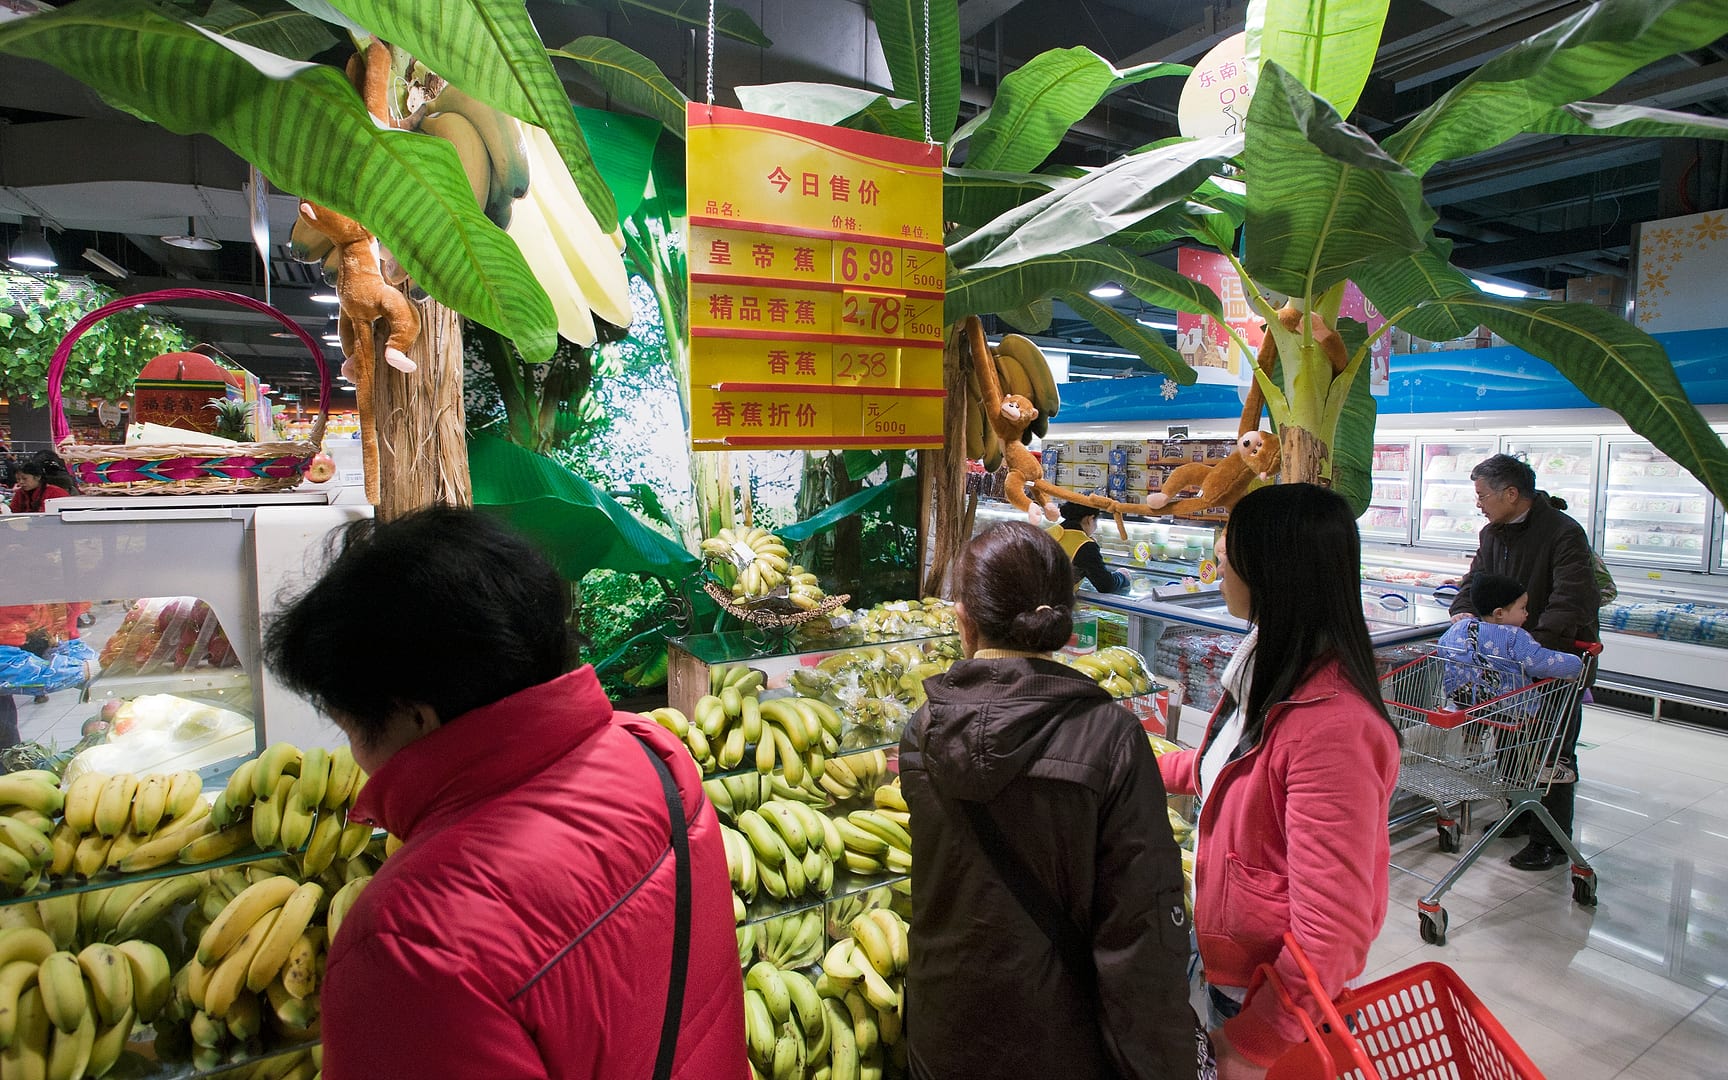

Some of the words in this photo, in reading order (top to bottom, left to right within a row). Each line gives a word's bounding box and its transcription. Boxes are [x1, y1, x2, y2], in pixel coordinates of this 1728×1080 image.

[767, 166, 880, 206] 今日售价
[708, 239, 816, 273] 皇帝蕉
[841, 246, 894, 282] 6.98
[709, 293, 817, 325] 精品香蕉
[842, 295, 901, 334] 2.78
[767, 350, 817, 376] 香蕉
[837, 352, 887, 381] 2.38
[711, 401, 818, 428] 香蕉折价
